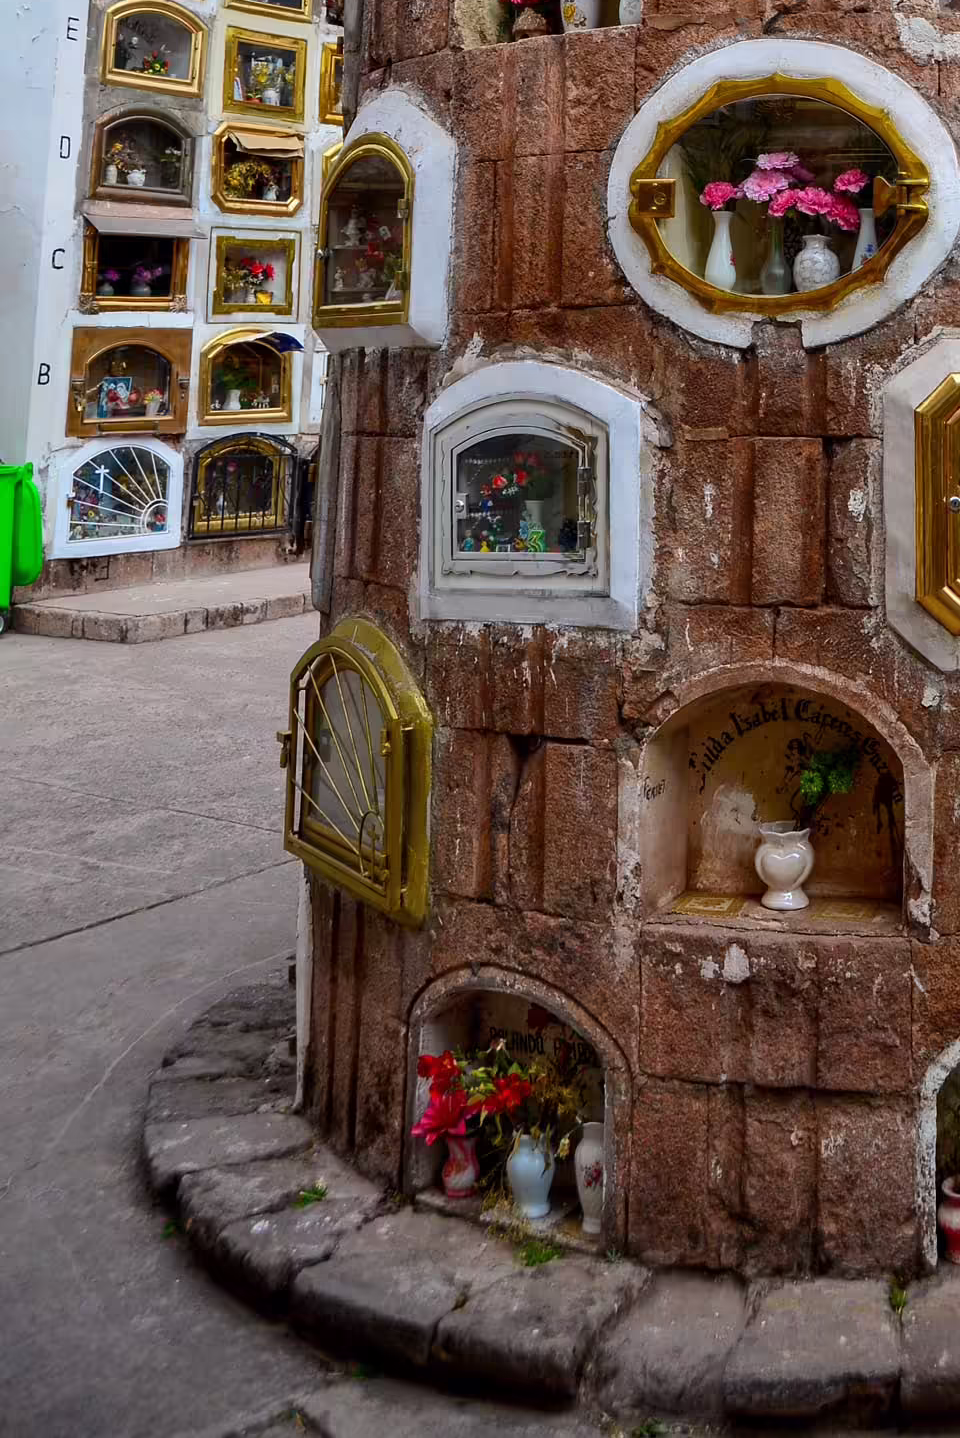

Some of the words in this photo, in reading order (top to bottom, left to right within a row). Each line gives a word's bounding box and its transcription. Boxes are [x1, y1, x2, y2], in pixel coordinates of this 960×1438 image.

[66, 17, 80, 41] E
[59, 135, 71, 159] D
[51, 248, 66, 269] C
[37, 363, 51, 386] B
